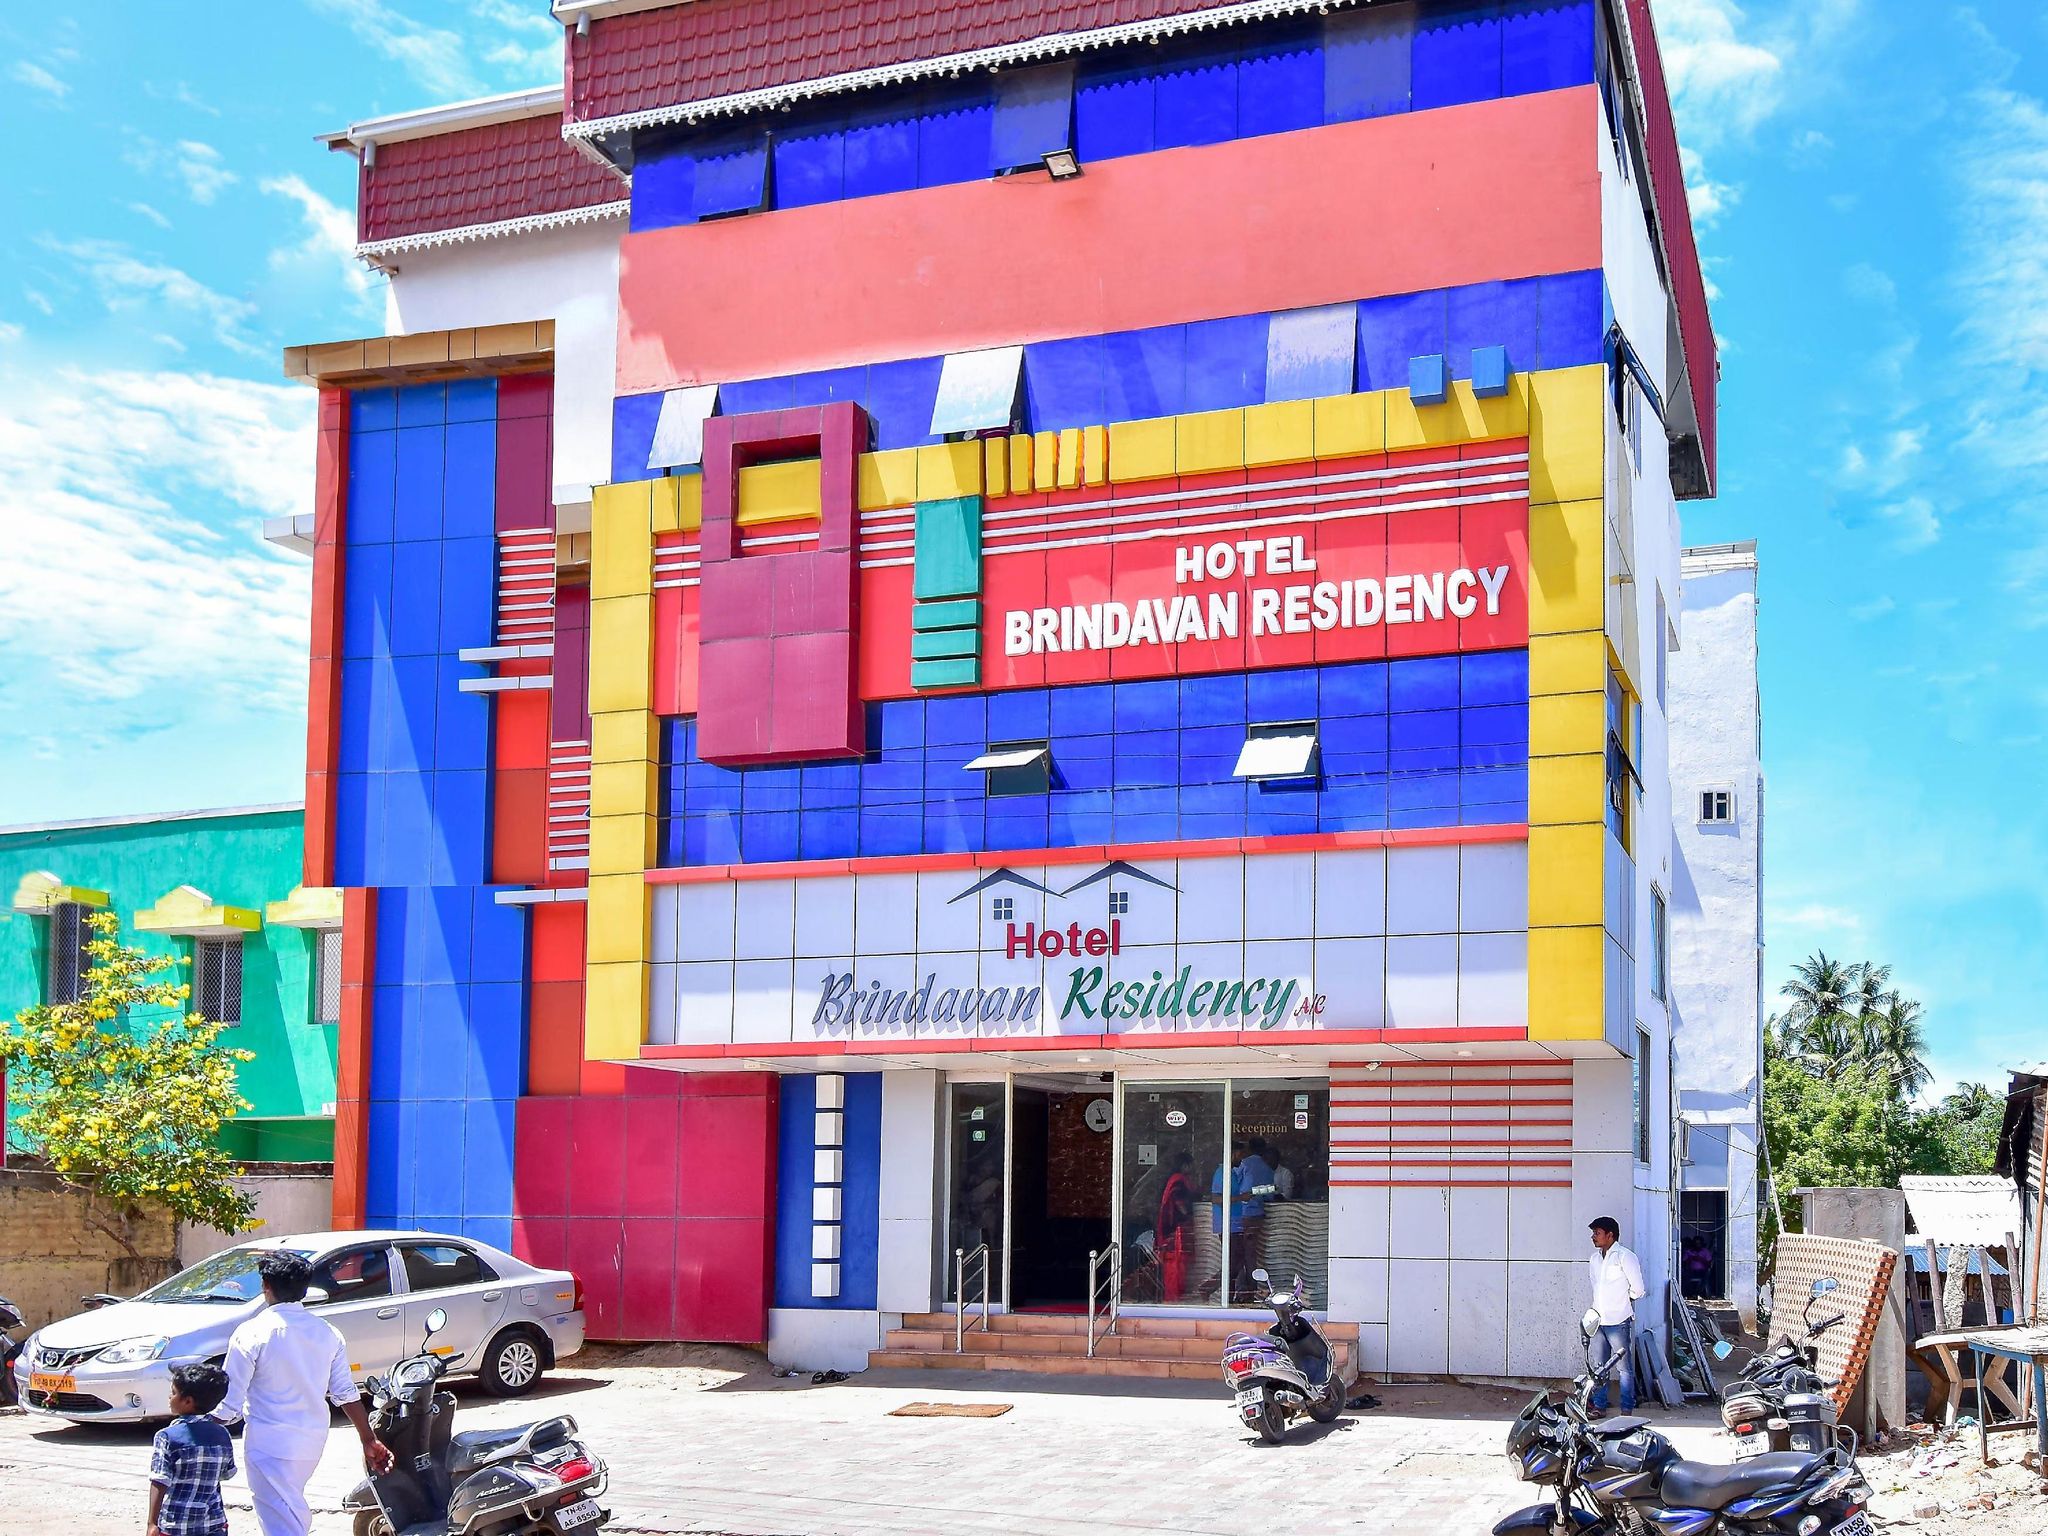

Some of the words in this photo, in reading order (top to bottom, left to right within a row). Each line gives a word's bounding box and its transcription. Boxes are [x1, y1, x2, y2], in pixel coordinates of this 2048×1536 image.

[1175, 535, 1317, 584] HOTEL
[1005, 591, 1239, 657] BRINDAVAN
[1252, 565, 1510, 636] RESIDENCY
[1005, 919, 1121, 960] Hotel
[811, 972, 1042, 1025] Brindavan
[1060, 964, 1297, 1030] Residency
[1293, 994, 1326, 1016] A/C
[1232, 1123, 1288, 1136] Reception
[564, 1510, 597, 1528] AE-8550
